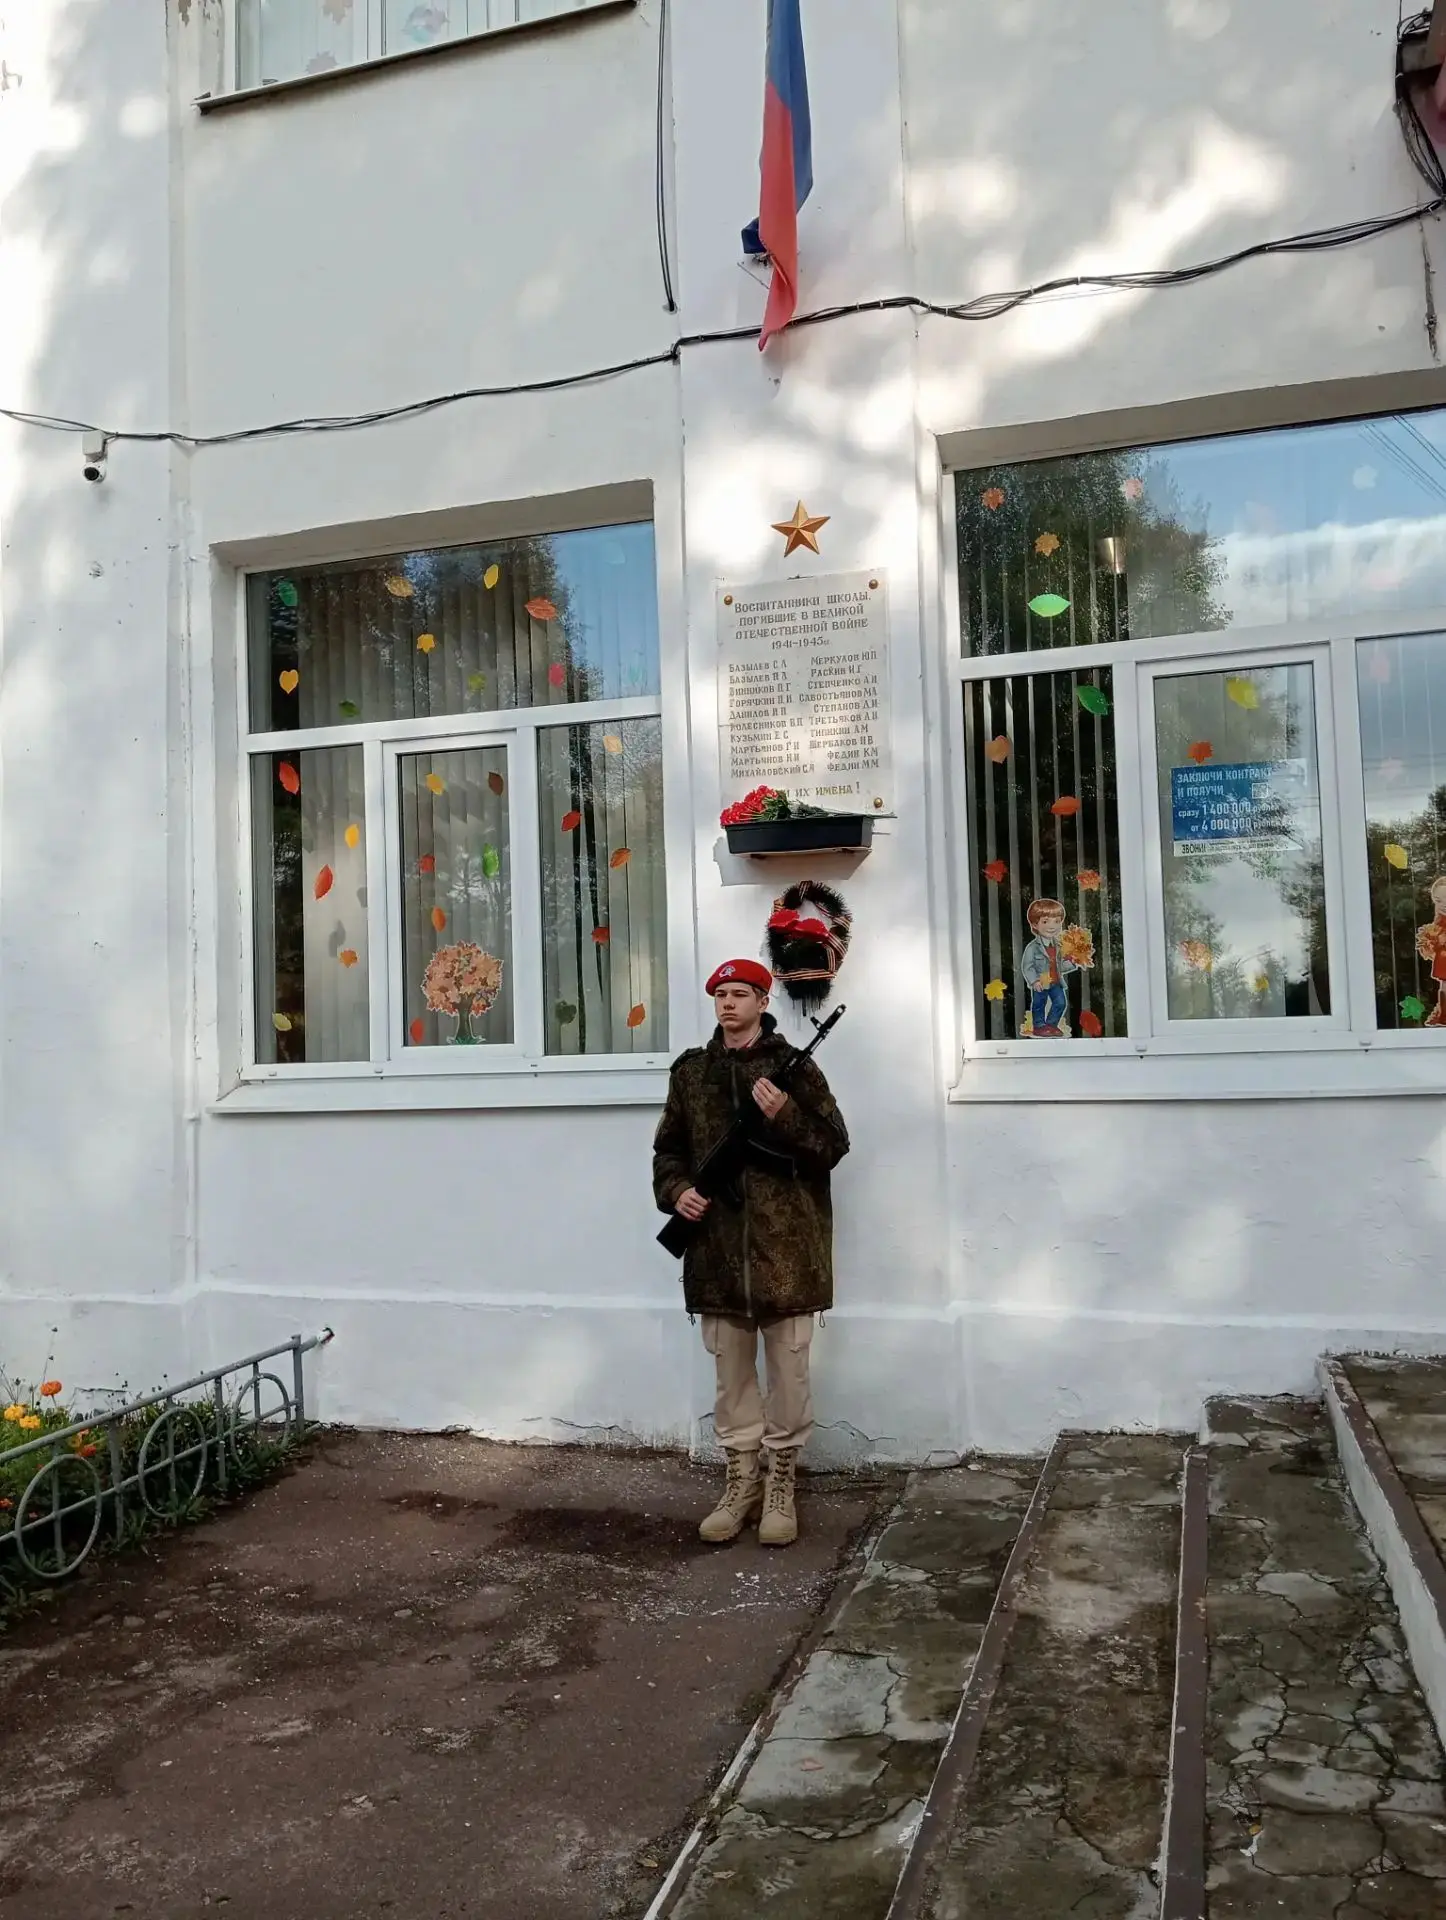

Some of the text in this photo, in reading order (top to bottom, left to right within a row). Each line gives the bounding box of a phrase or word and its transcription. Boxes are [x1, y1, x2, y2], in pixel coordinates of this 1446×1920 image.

[739, 603, 864, 627] ПОГИБШИЕ В ВЕЛИКОЙ
[735, 617, 868, 640] ОТЕЧЕСТВЕННОЙ ВОЙНЕ
[1177, 771, 1222, 784] ЗАКЛЮЧИ
[795, 787, 810, 797] ИХ
[1177, 784, 1224, 798] И ПОЛУЧИ
[1178, 809, 1200, 819] сразу
